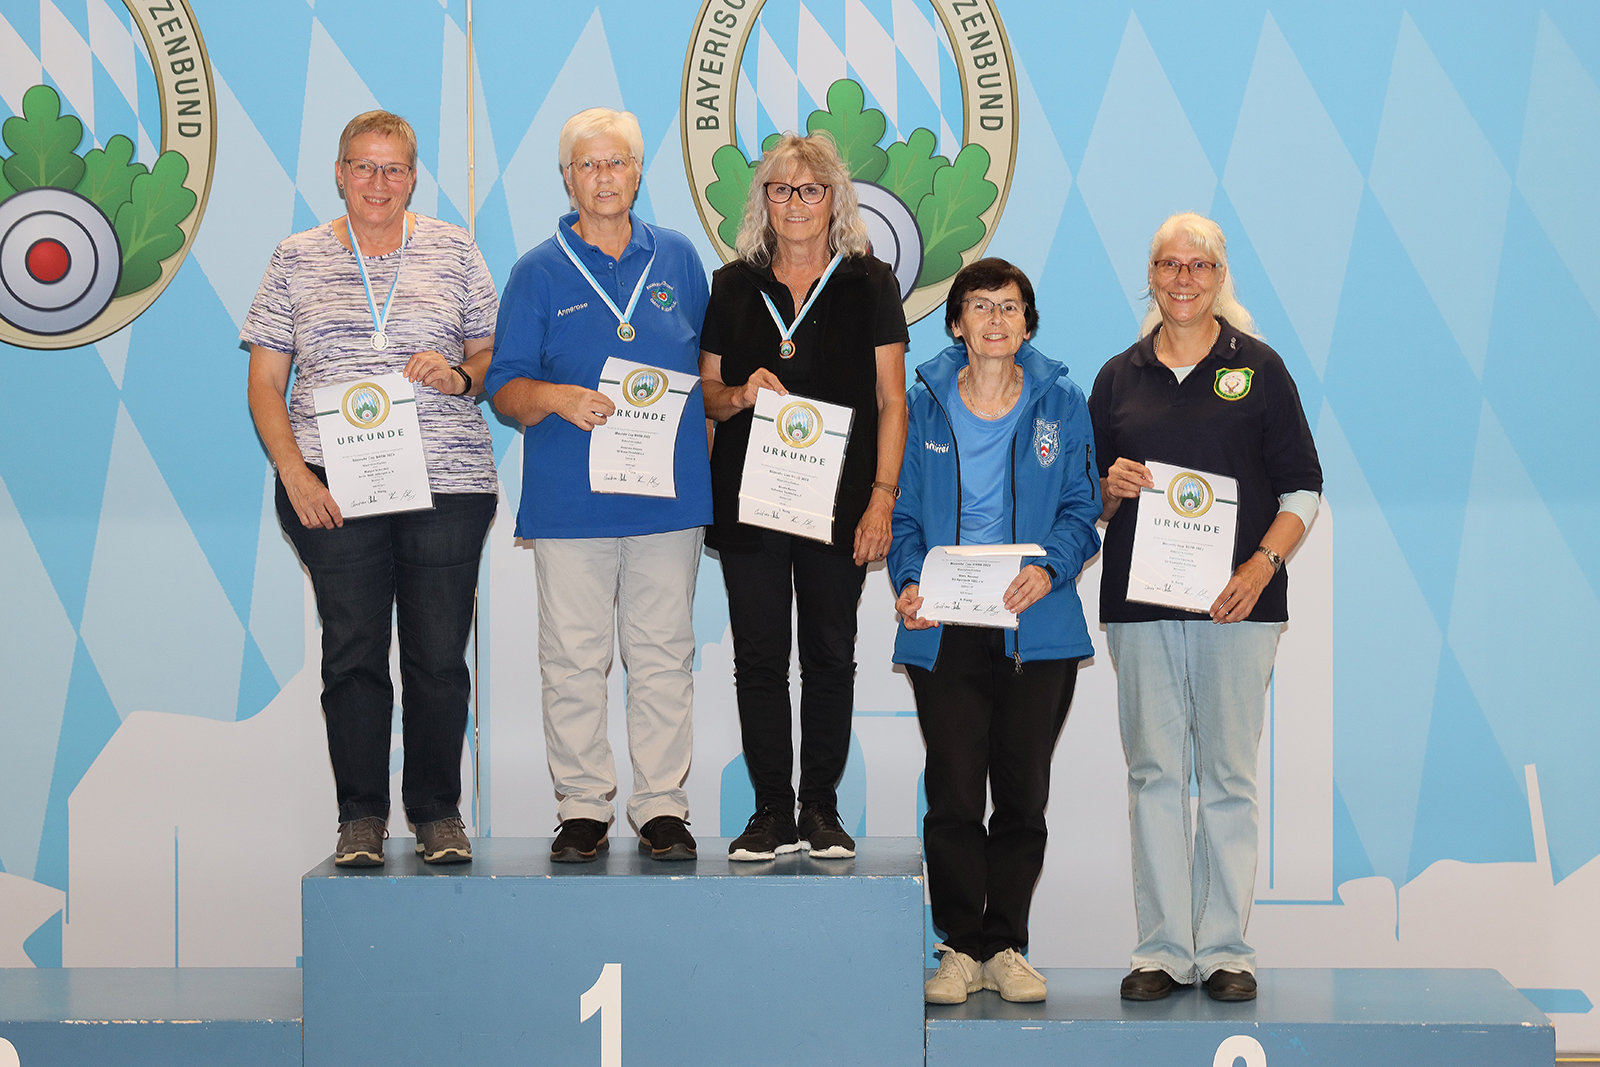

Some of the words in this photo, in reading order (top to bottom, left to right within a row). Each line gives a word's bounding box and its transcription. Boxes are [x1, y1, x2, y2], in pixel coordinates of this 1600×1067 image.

[612, 408, 667, 422] RKUNDE
[337, 428, 405, 446] URKUNDE
[762, 446, 827, 466] URKUNDE
[1154, 519, 1220, 533] URKUNDE
[580, 963, 622, 1067] 1
